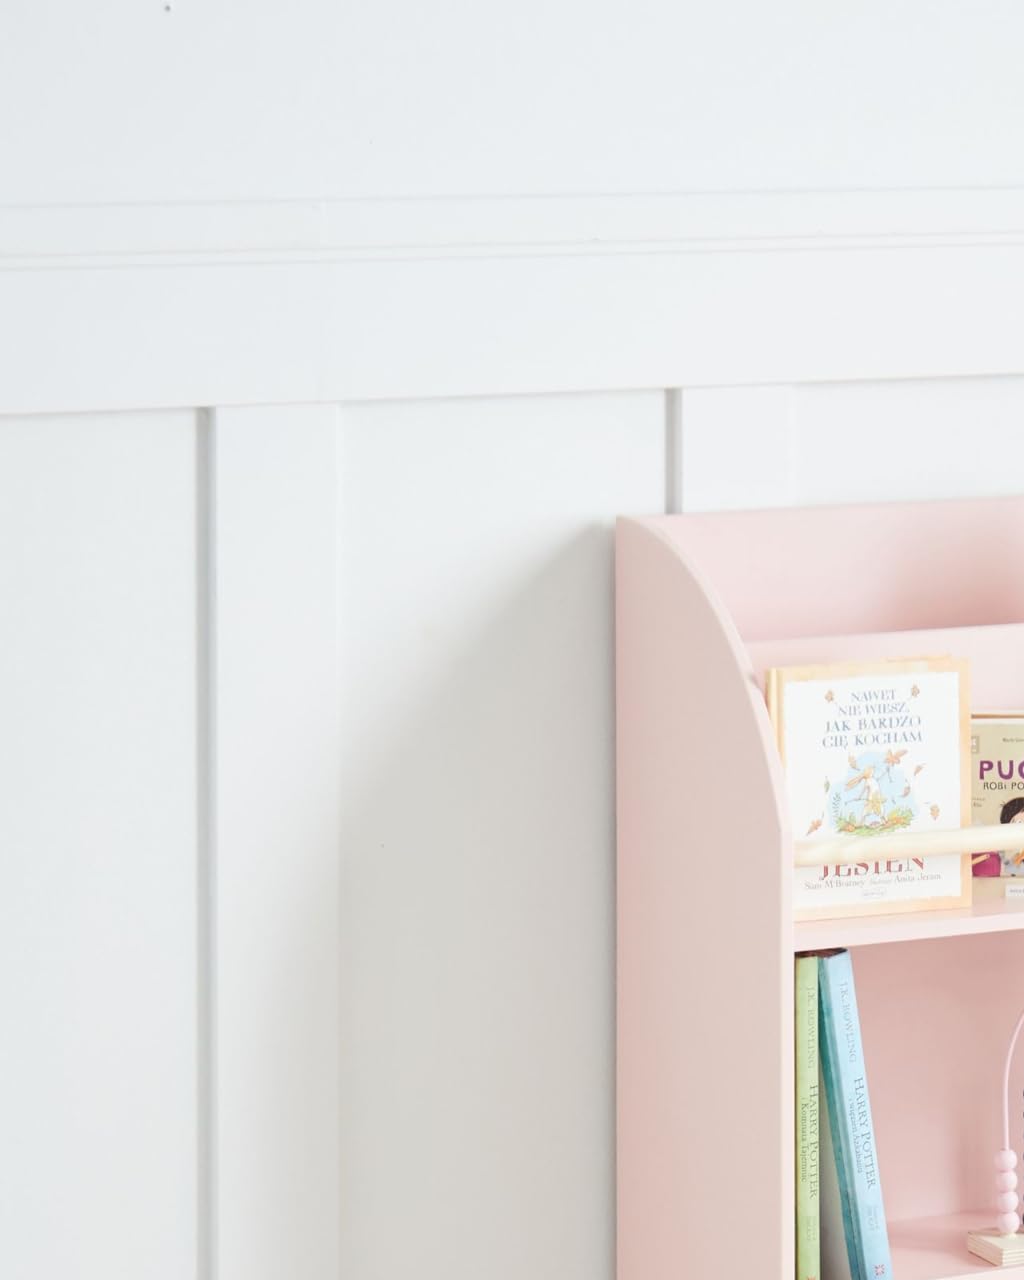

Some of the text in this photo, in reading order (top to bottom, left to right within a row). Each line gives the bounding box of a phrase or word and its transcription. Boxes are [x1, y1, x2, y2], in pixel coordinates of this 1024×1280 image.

[839, 704, 862, 716] NIE
[851, 689, 896, 702] NAWET
[822, 731, 922, 750] CIĘ KOCHAM
[826, 715, 921, 732] JAK BARDZO
[807, 1009, 816, 1069] ROWLING
[843, 1004, 857, 1063] ROWLING
[854, 1077, 869, 1128] HARRY
[810, 1084, 819, 1200] HARRY POTTER
[861, 1131, 877, 1189] POTTER
